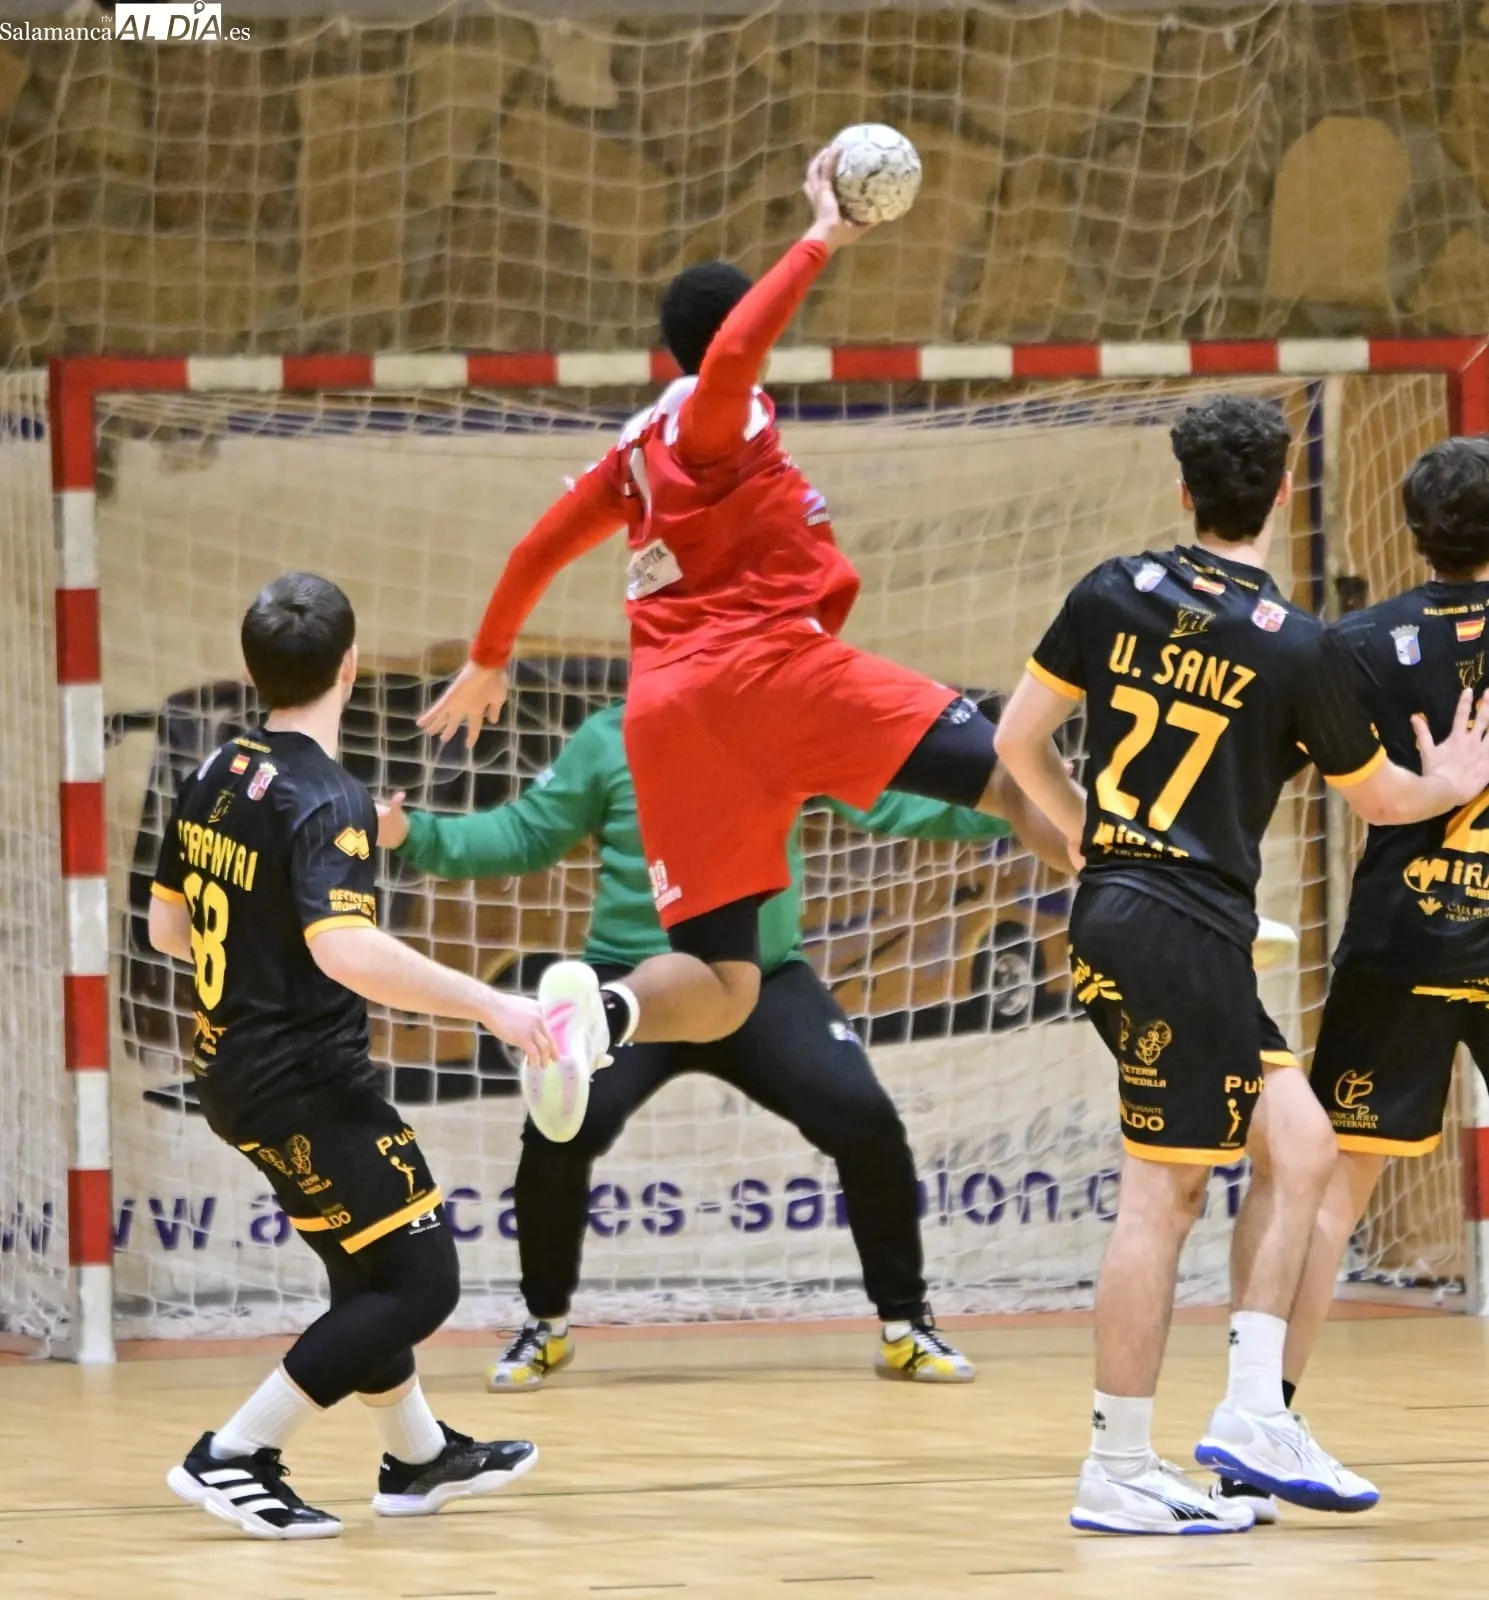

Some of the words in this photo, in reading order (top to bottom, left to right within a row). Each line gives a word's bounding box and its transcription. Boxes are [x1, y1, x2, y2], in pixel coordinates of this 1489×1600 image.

[1108, 632, 1142, 678] U.
[1152, 643, 1257, 709] SANZ
[1095, 684, 1231, 832] 27
[1403, 856, 1489, 893] MiR
